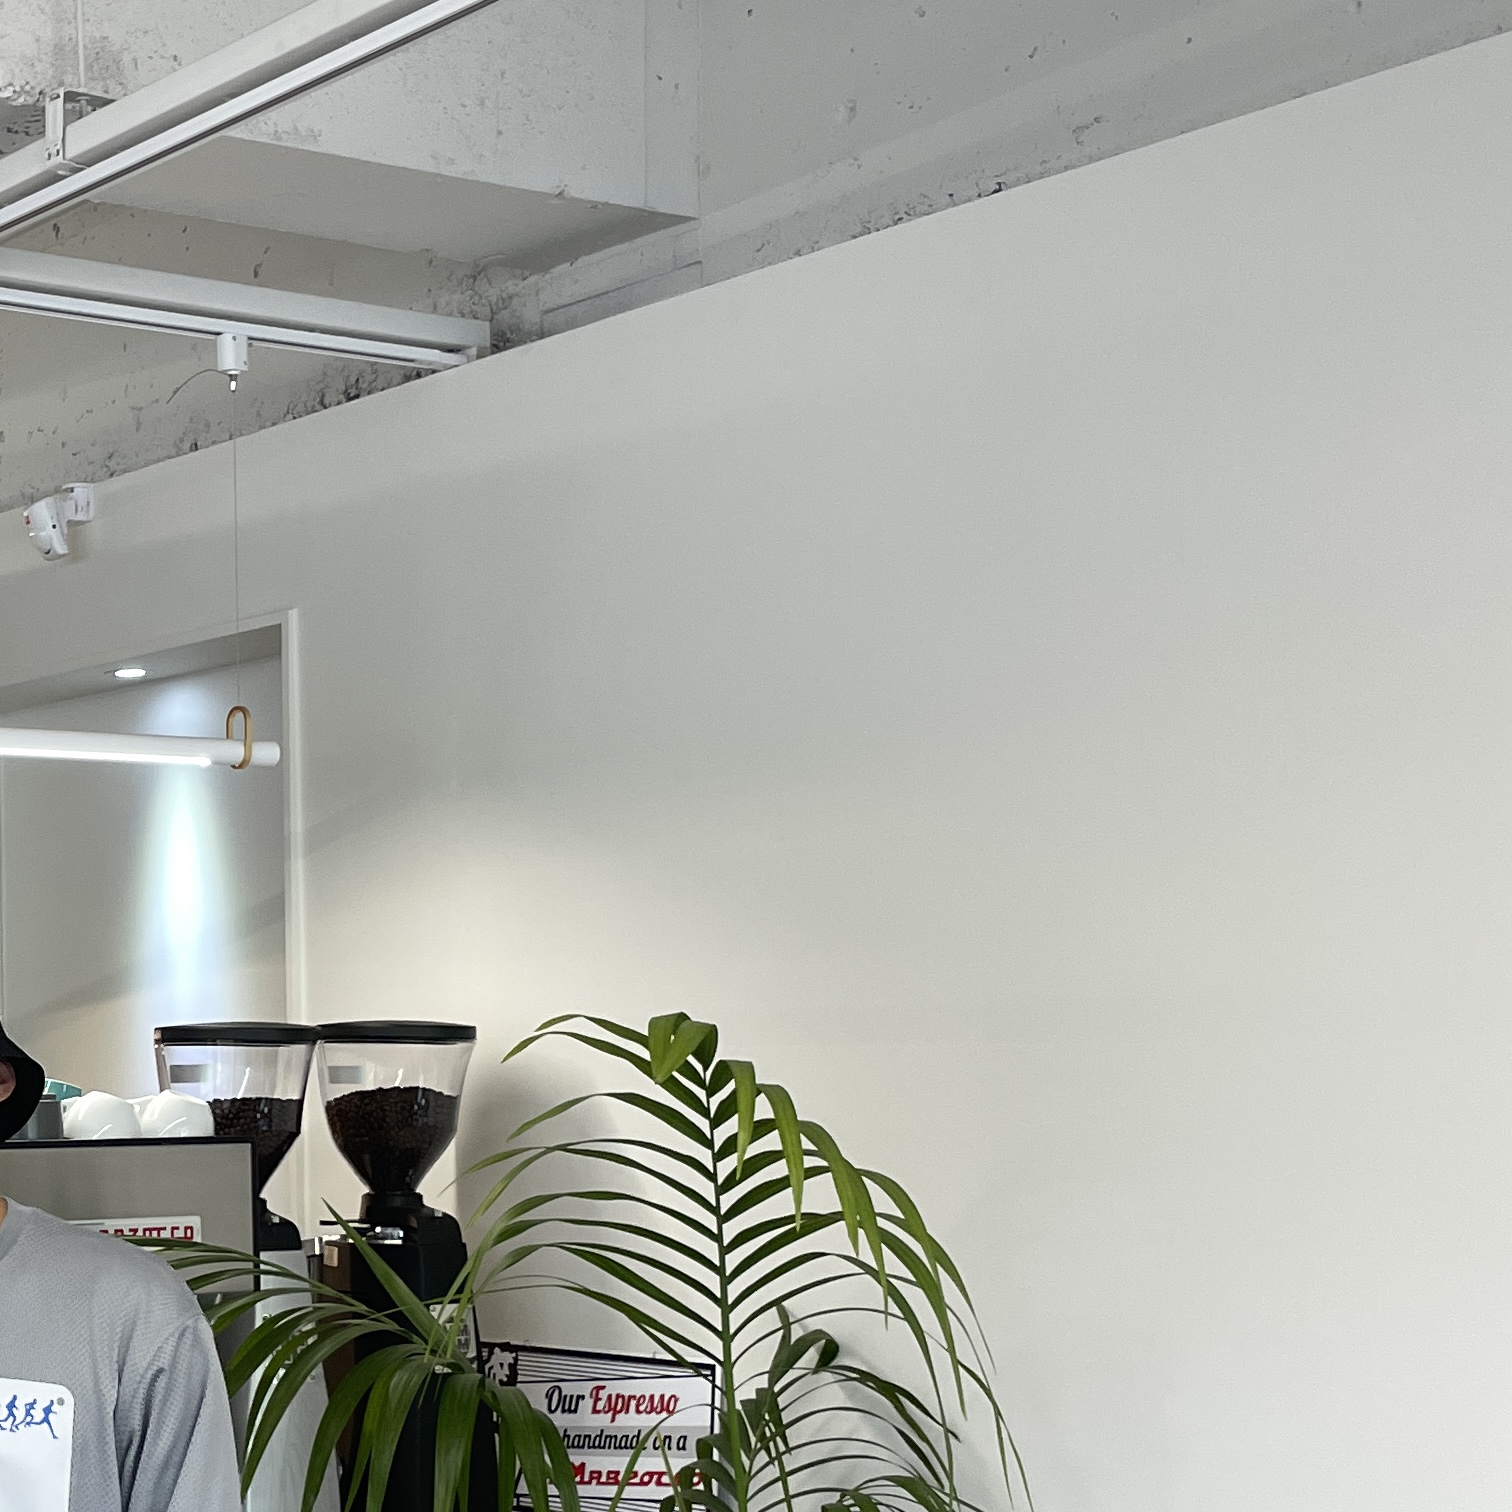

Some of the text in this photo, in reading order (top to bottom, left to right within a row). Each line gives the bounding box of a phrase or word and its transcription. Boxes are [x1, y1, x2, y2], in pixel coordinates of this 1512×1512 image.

[545, 1385, 680, 1423] Our Espresso
[676, 1434, 687, 1451] a
